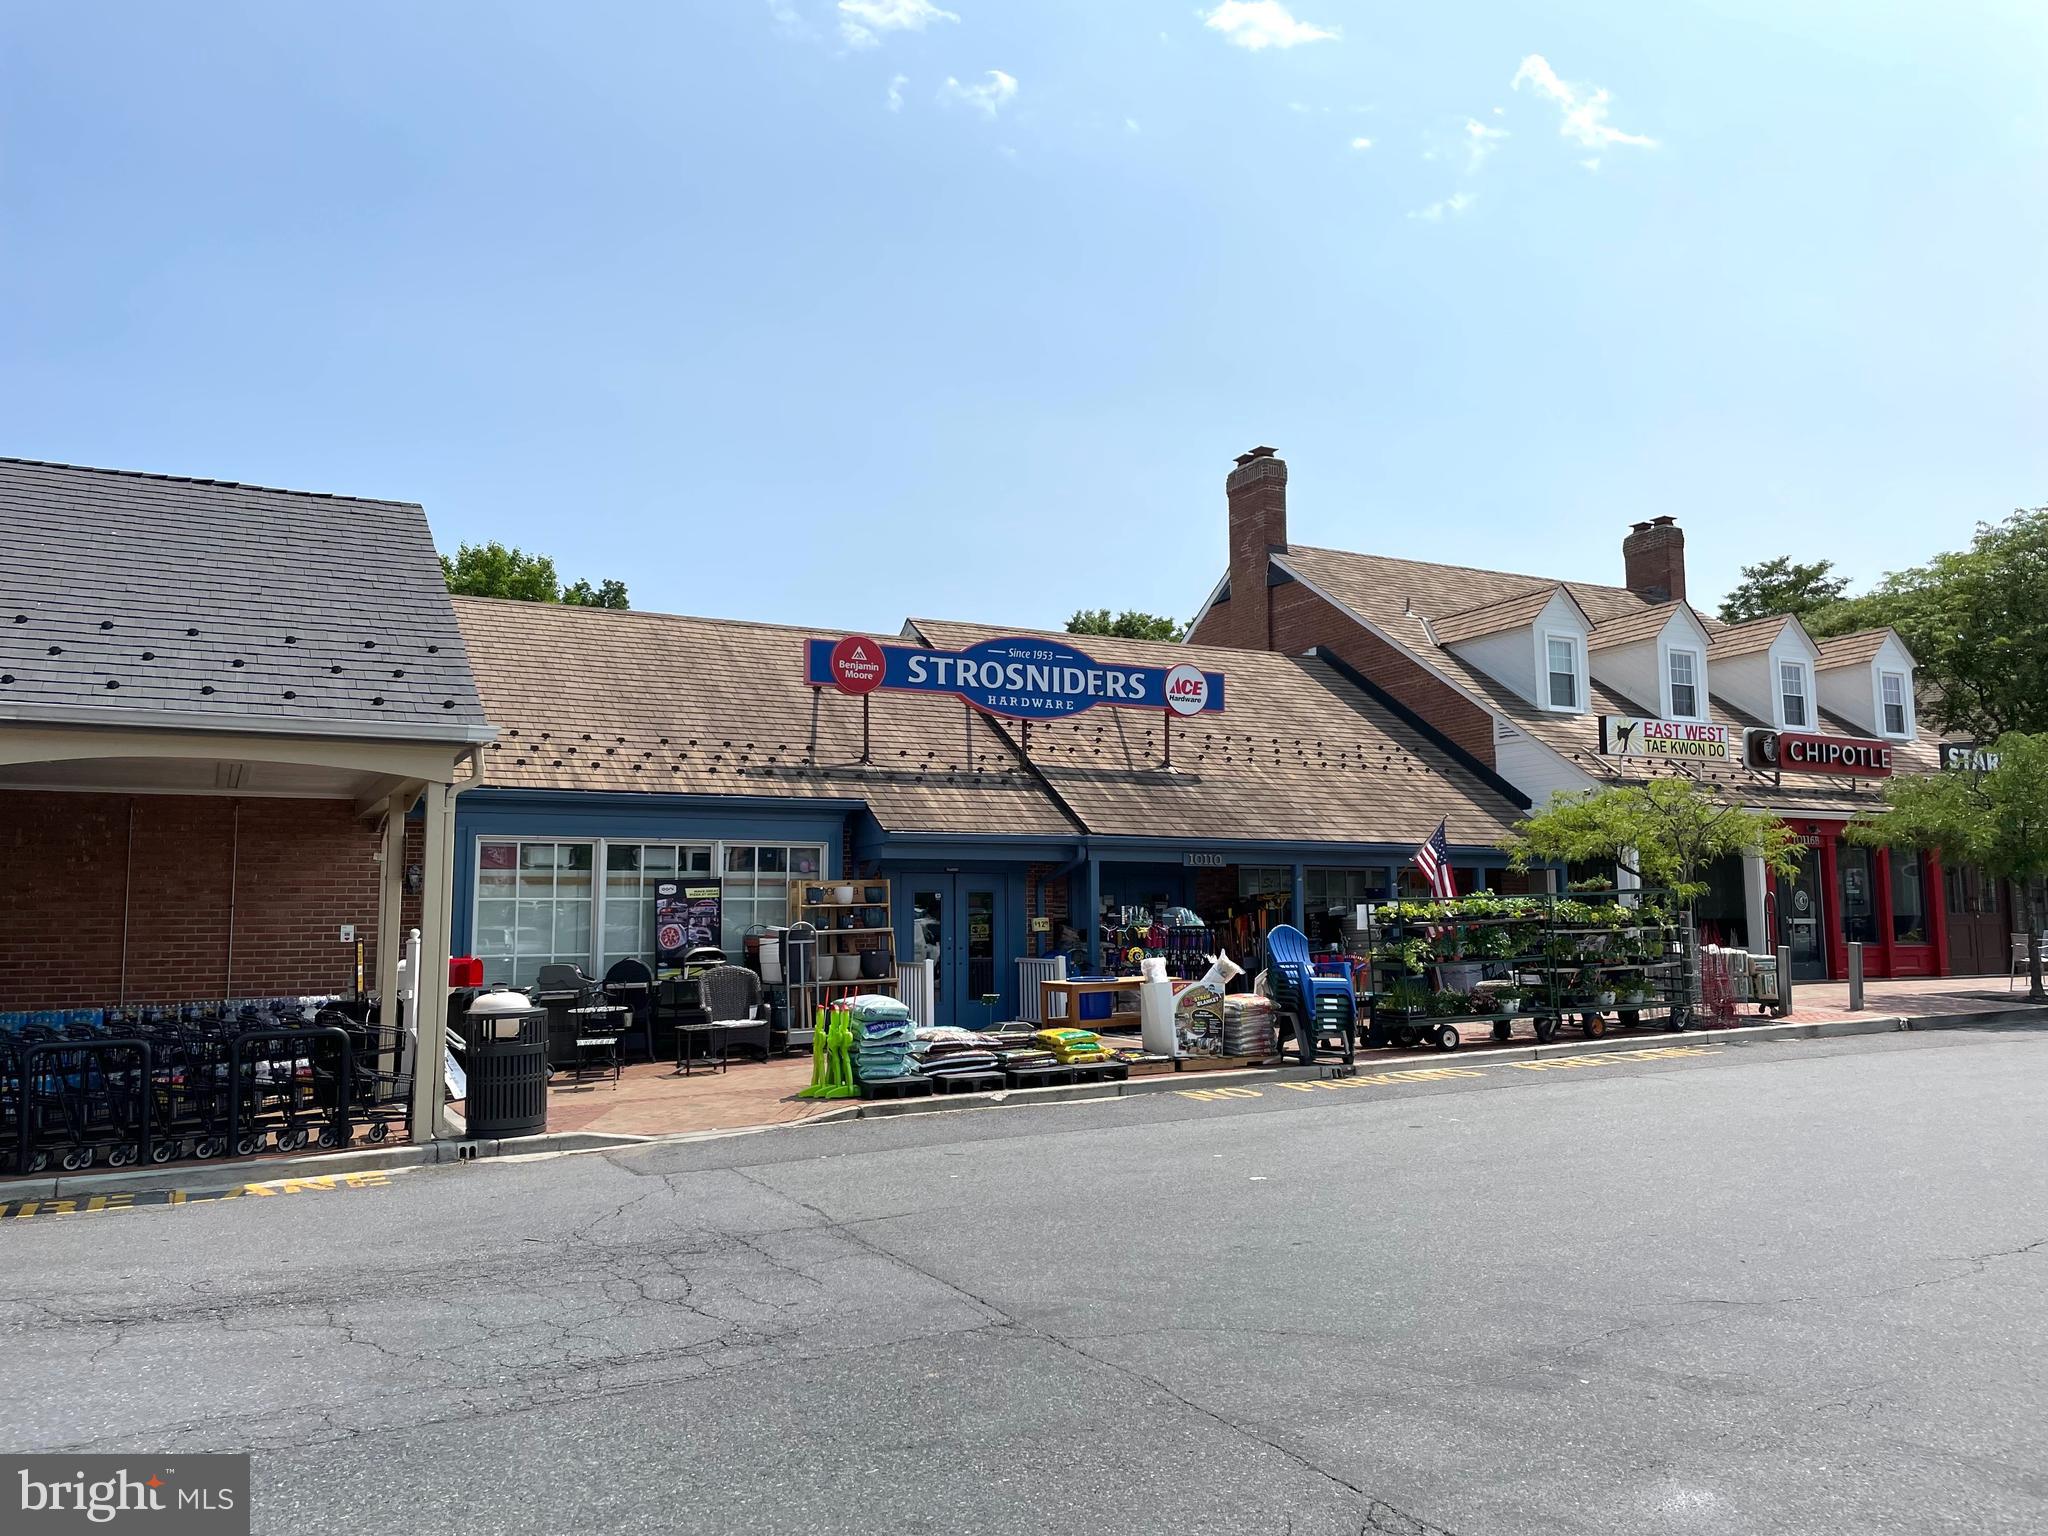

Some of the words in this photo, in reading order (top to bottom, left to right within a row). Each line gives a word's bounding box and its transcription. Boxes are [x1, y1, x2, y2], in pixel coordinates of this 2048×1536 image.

[1008, 648, 1031, 659] Since
[1033, 650, 1053, 660] 1953
[839, 660, 879, 671] Benjamin
[845, 670, 873, 680] Moore
[907, 655, 1146, 699] STROSNIDERS
[1169, 677, 1203, 695] ACE
[988, 696, 1074, 710] HARDWARE
[1169, 695, 1201, 703] Hardware
[1644, 722, 1681, 739] EAST
[1685, 725, 1724, 742] WEST
[1645, 740, 1667, 753] TAE
[1671, 741, 1705, 756] KWON
[1709, 744, 1725, 757] DO
[1790, 741, 1891, 768] CHIPOTLE
[1948, 747, 2000, 771] STAR
[1189, 854, 1222, 865] 10110
[1176, 1087, 1263, 1101] NO
[1276, 1068, 1487, 1092] PARKING
[169, 1171, 394, 1205] LANE
